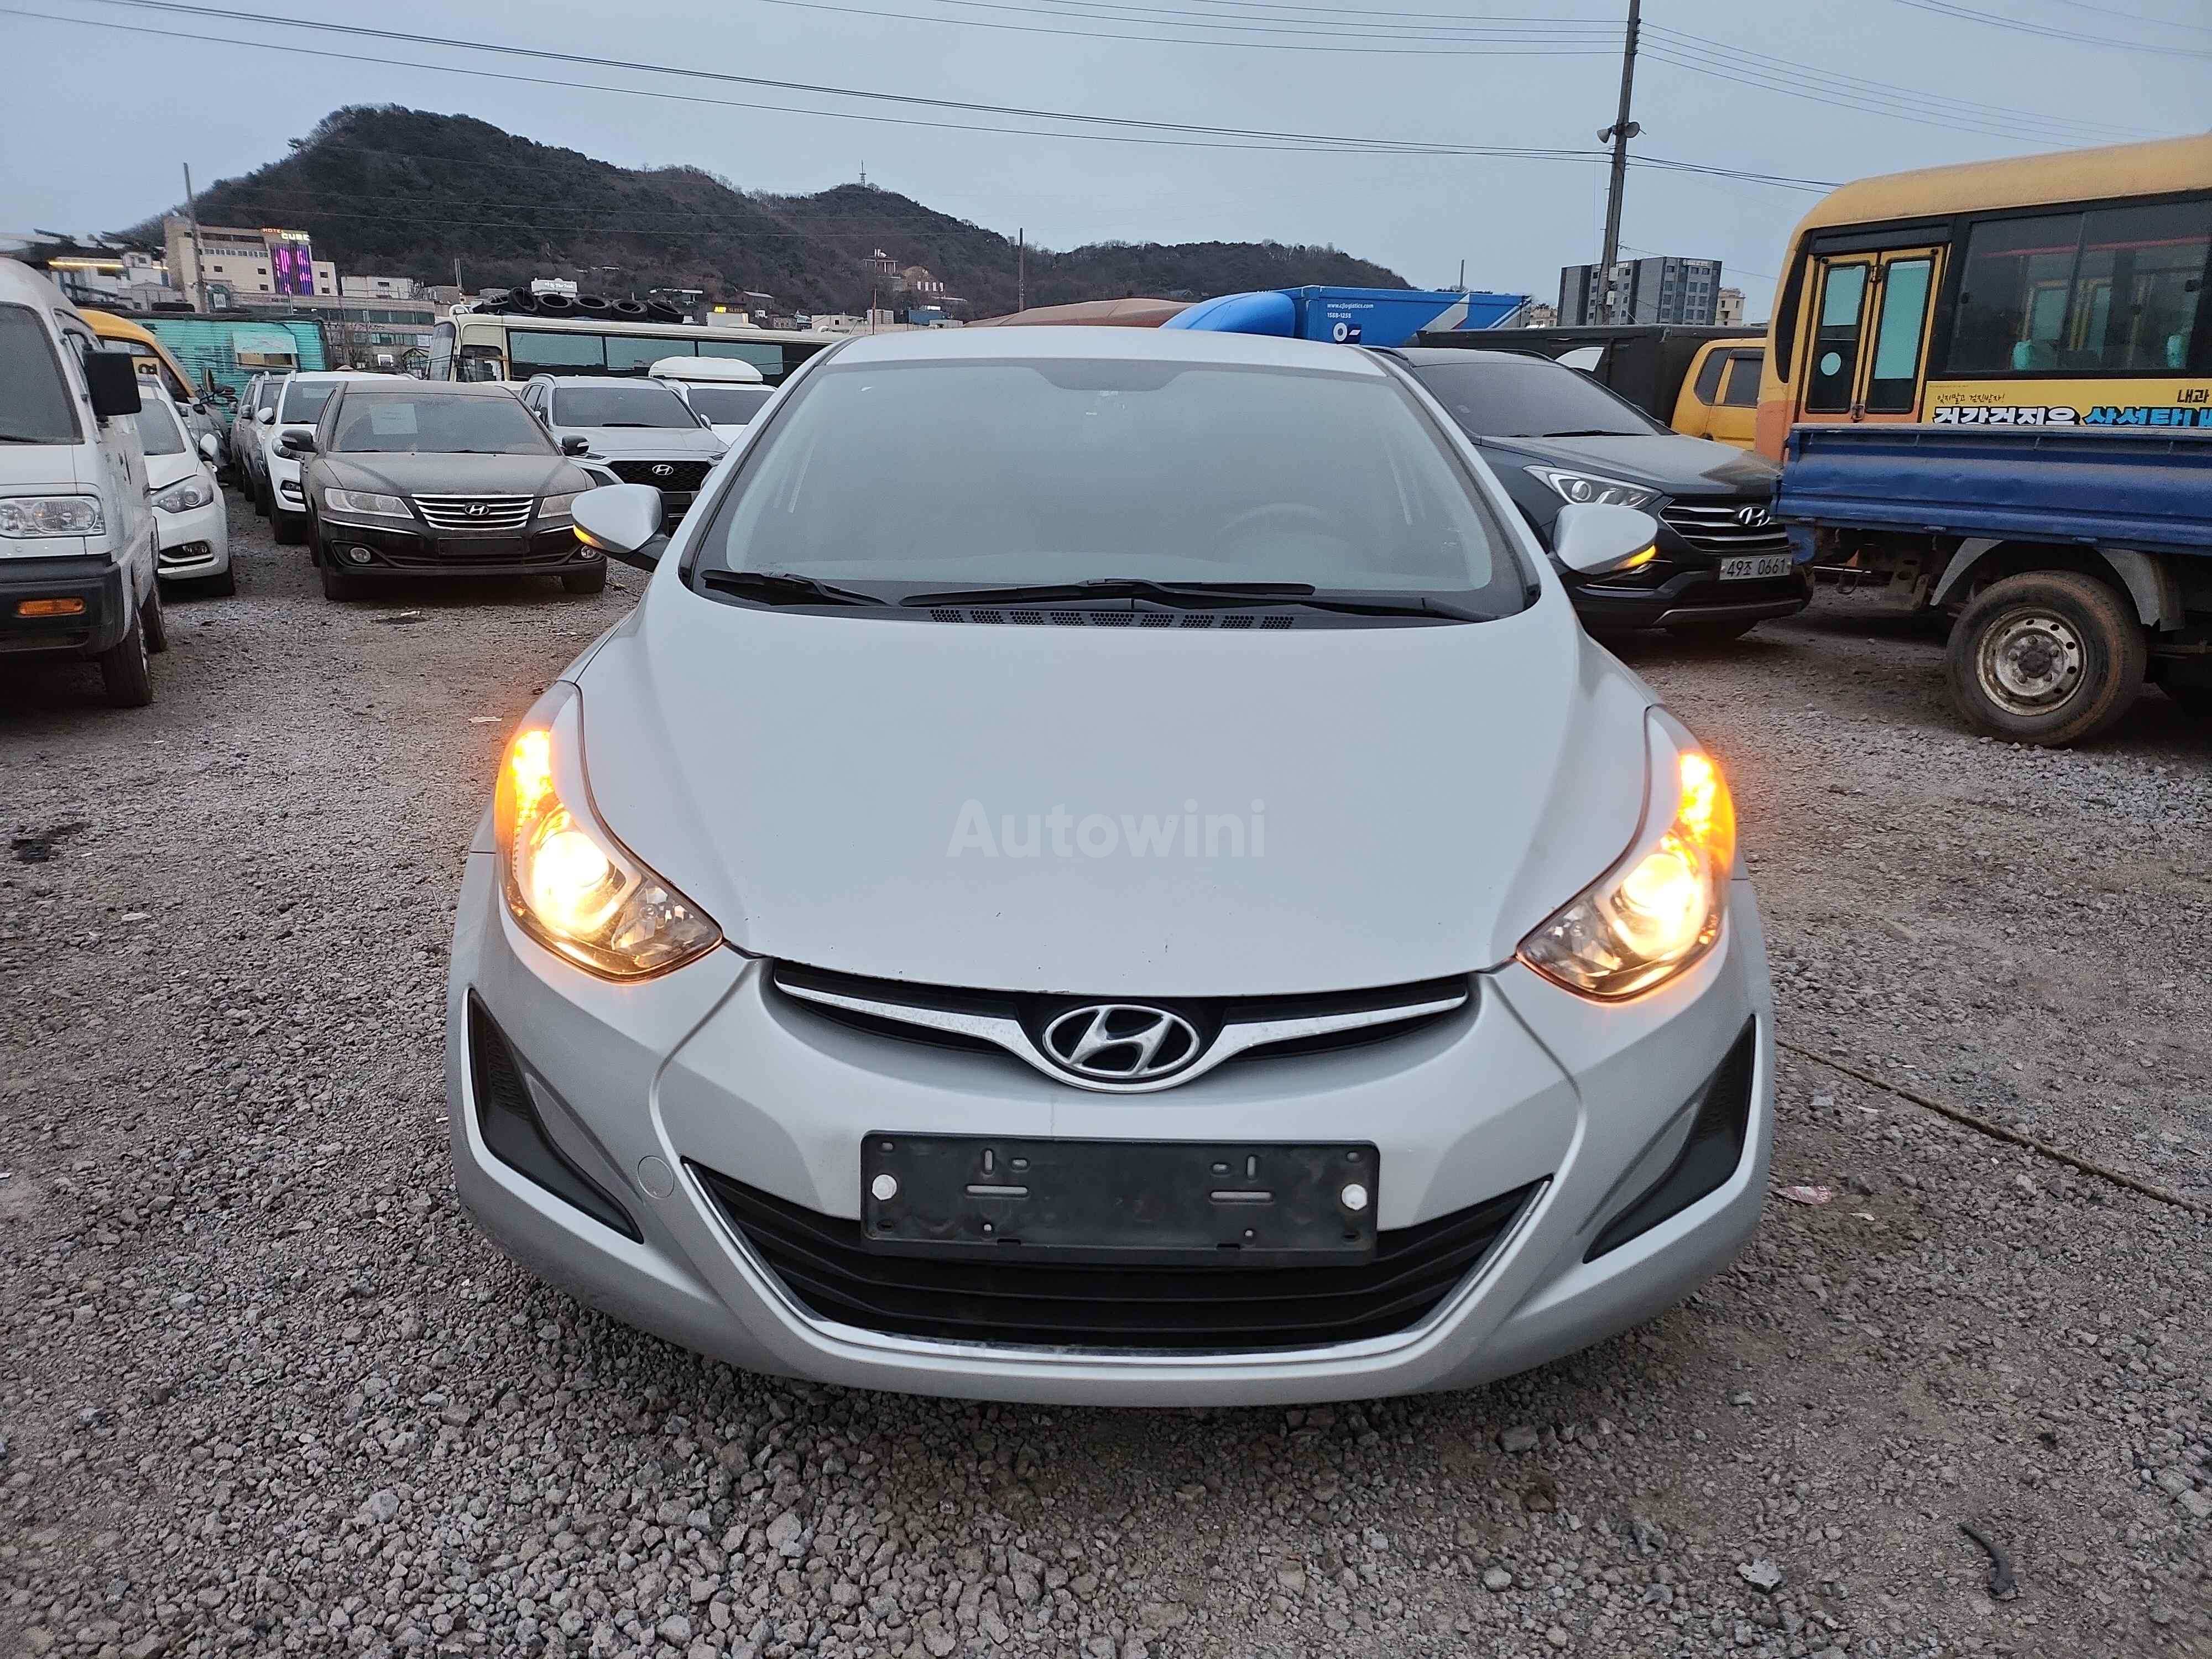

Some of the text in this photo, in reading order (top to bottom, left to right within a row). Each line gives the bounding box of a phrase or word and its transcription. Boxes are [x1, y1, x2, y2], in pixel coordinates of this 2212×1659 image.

[2177, 389, 2210, 404] 내과
[1726, 557, 1786, 577] 49조 0661
